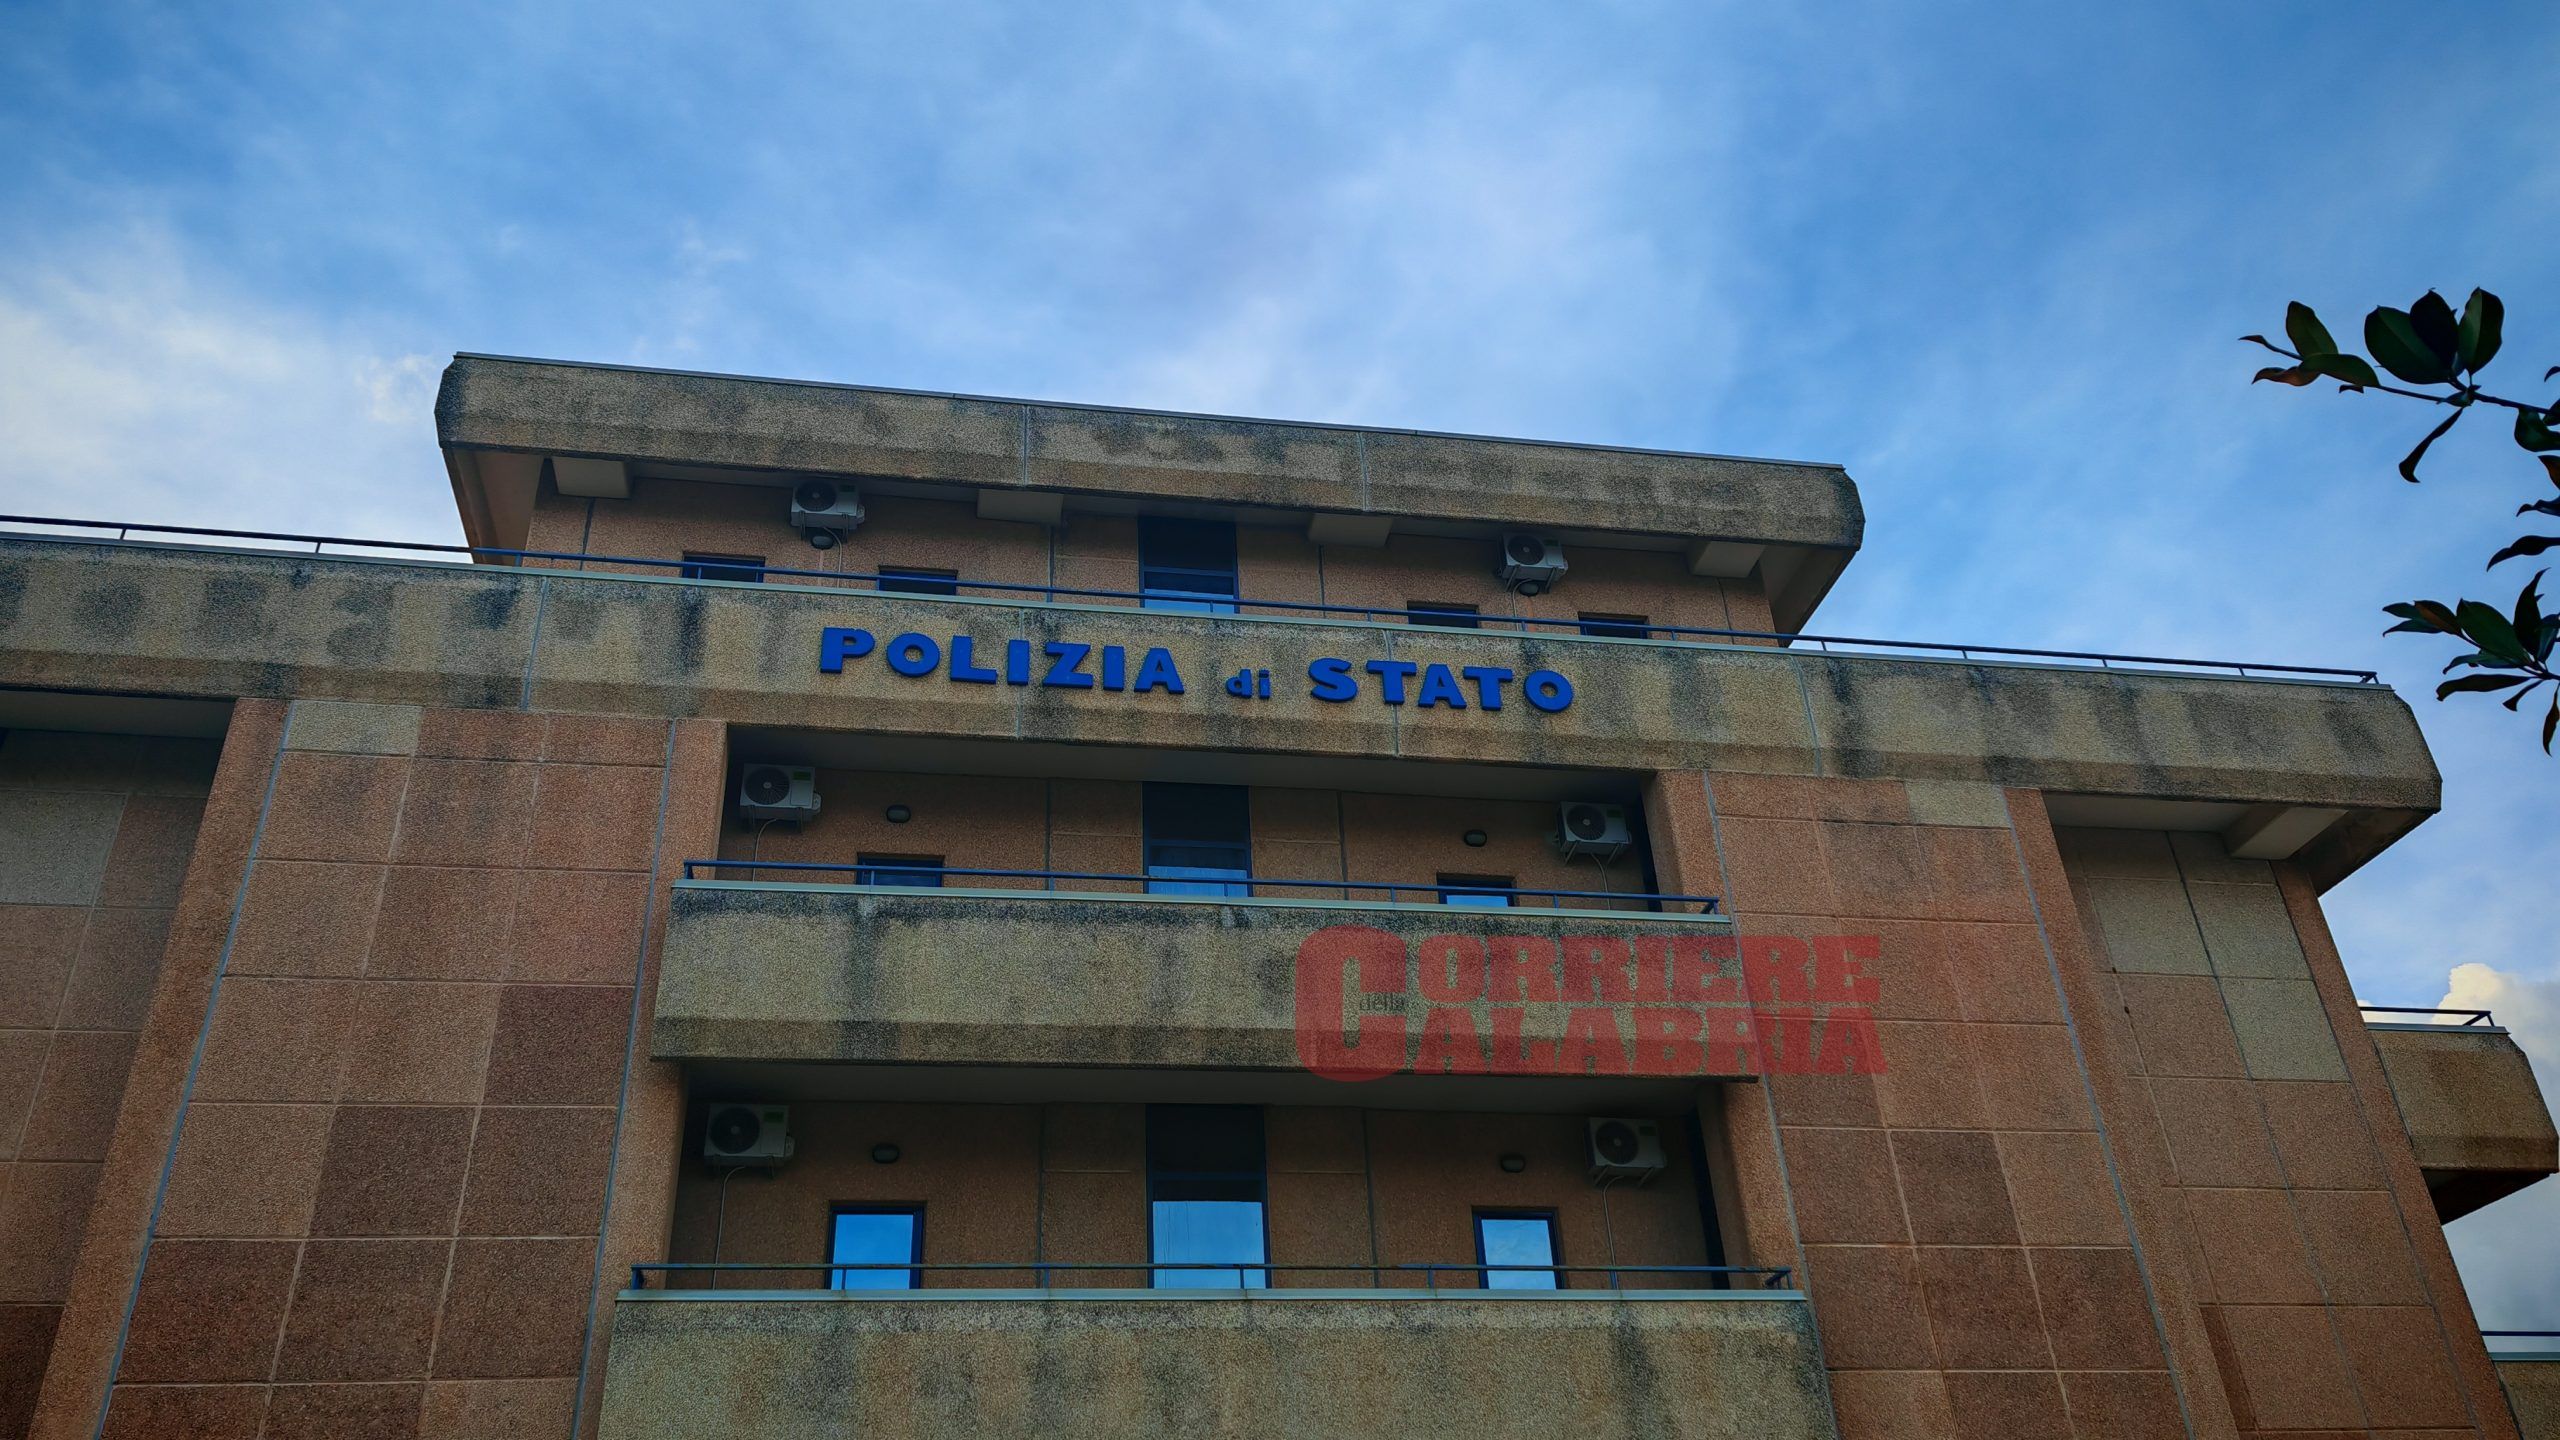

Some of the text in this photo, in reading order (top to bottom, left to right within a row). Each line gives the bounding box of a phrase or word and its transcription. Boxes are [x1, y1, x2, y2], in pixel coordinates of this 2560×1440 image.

[819, 626, 1574, 713] POLIZIA di STATO
